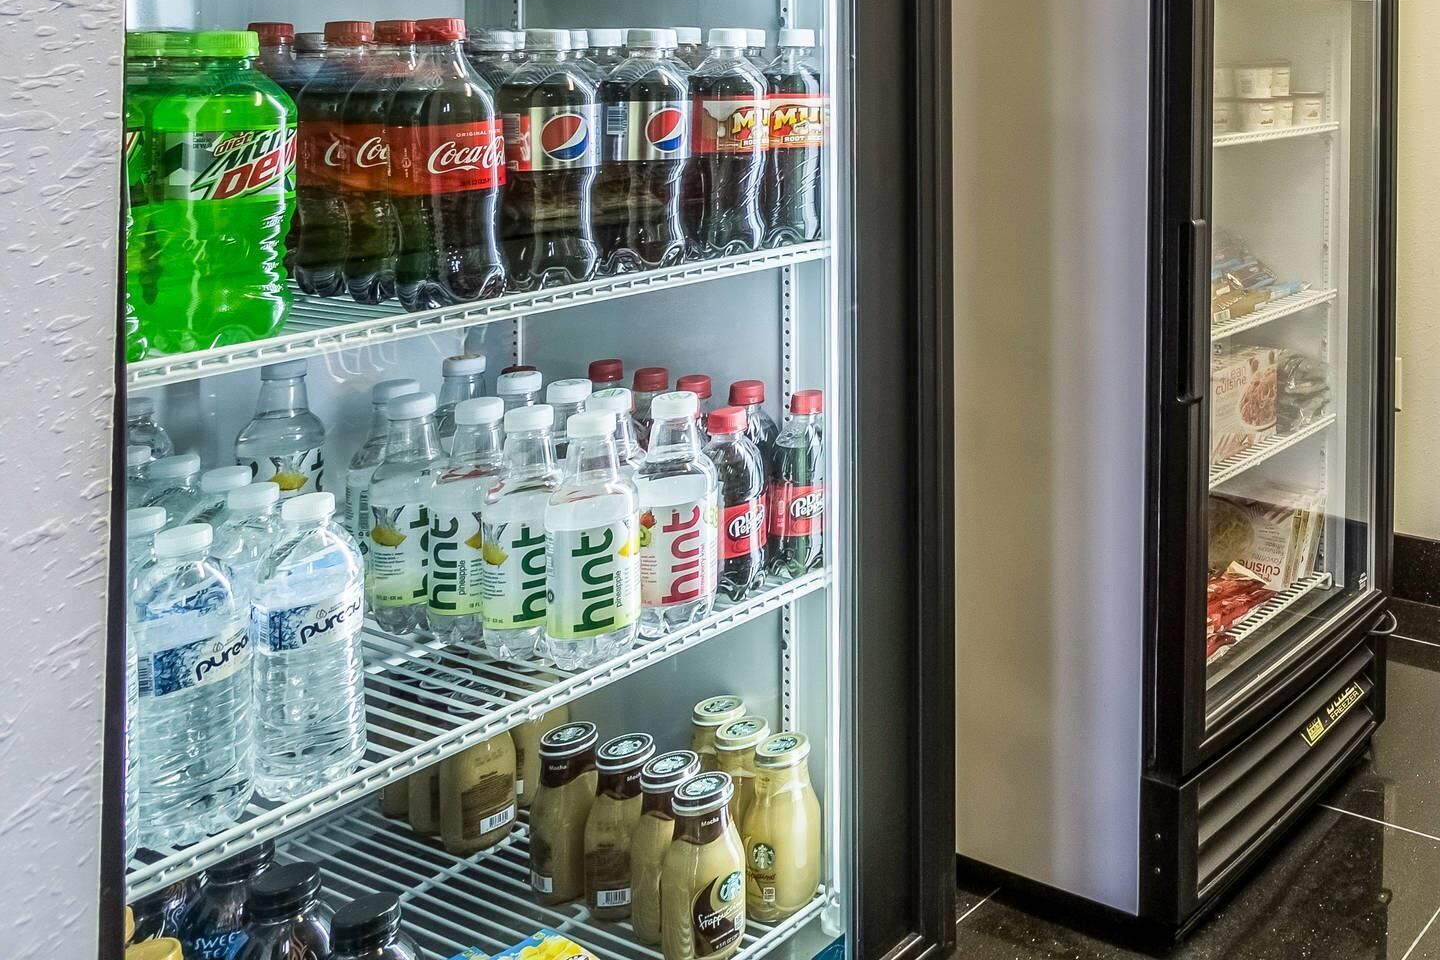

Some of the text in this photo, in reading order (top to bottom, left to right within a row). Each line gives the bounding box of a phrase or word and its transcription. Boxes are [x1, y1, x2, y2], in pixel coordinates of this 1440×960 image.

[428, 515, 459, 611] hint
[662, 505, 701, 605] hint
[458, 559, 468, 596] pineapple
[571, 528, 615, 633] hint
[1329, 690, 1360, 721] FREEZER
[700, 816, 720, 828] Mocha
[194, 930, 241, 951] SWEE
